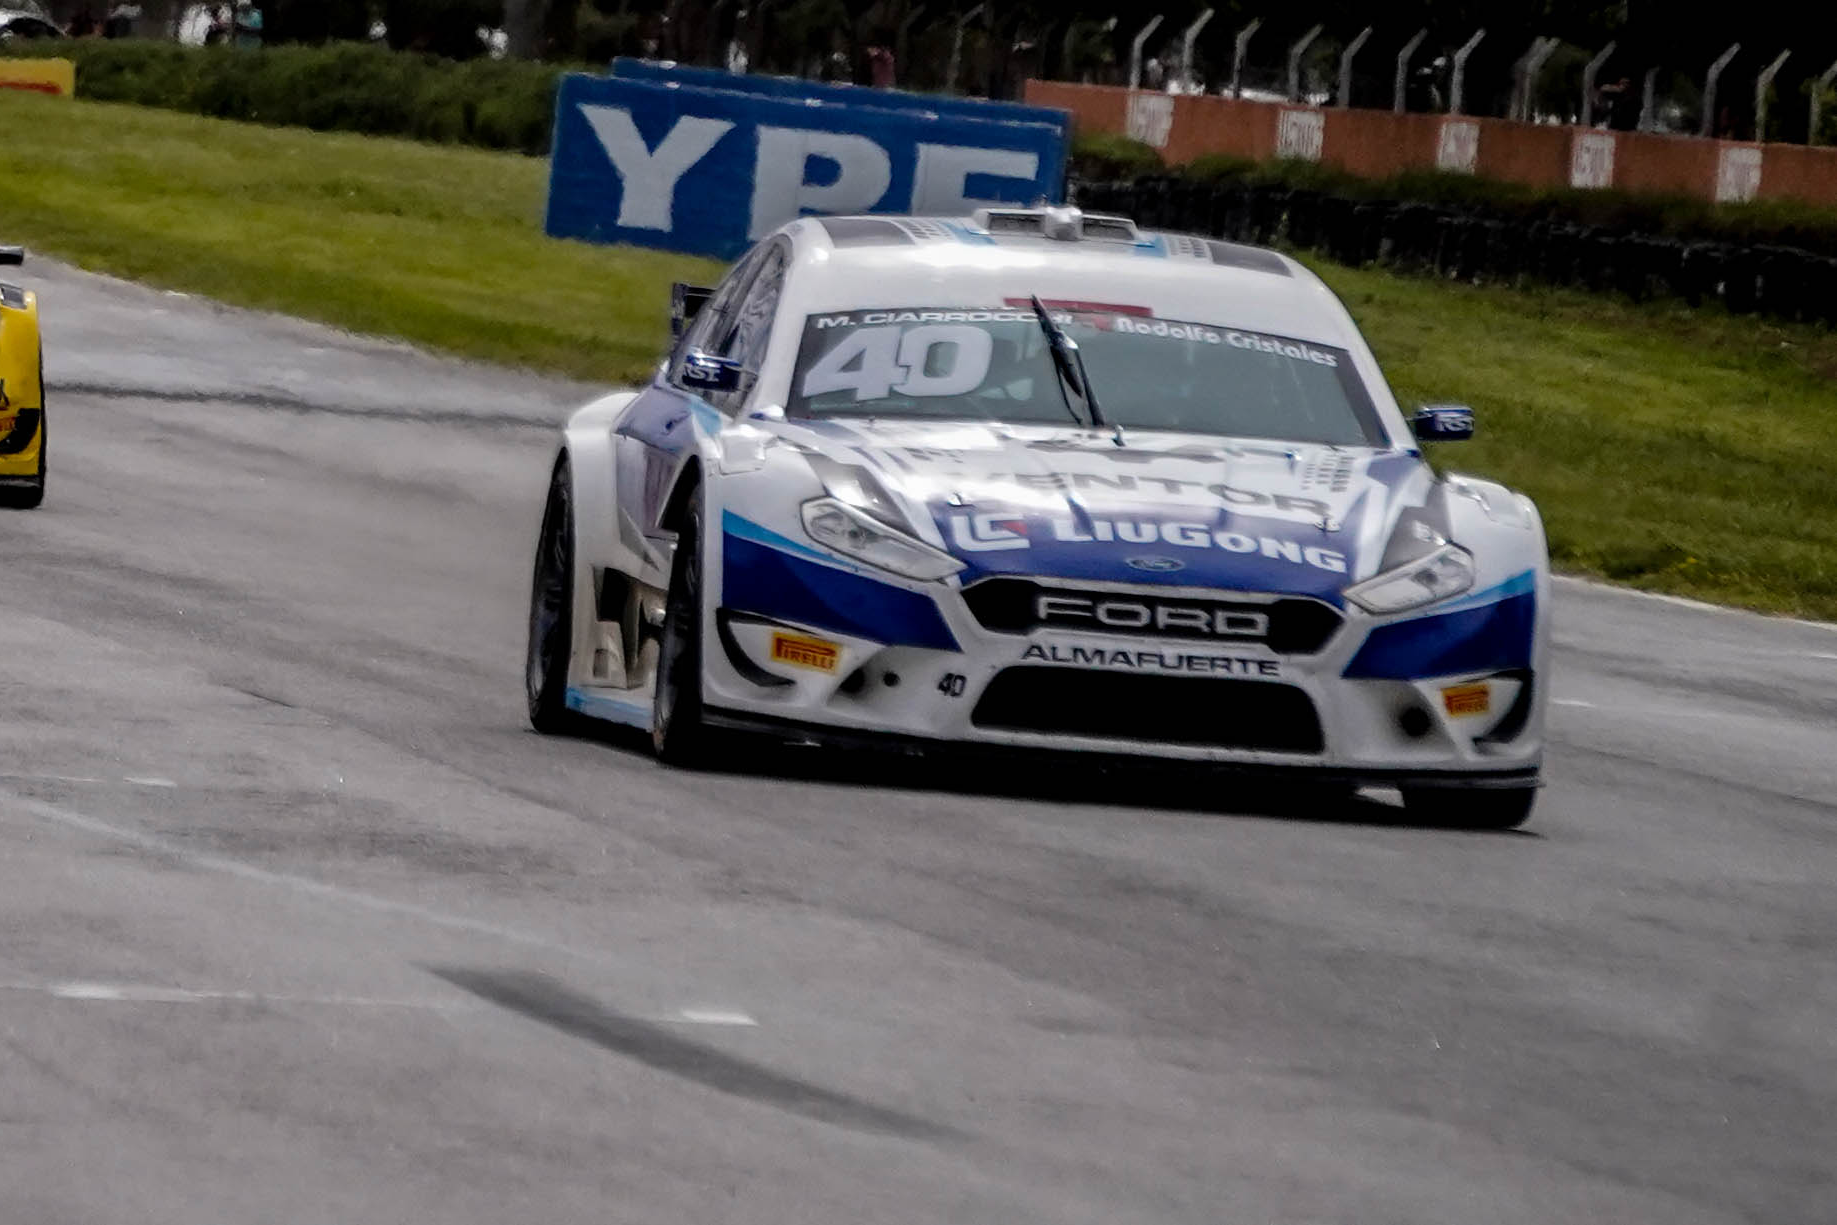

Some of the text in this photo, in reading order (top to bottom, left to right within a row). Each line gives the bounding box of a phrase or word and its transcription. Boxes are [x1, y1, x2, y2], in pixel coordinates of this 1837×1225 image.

[817, 316, 857, 329] M.
[1115, 317, 1338, 368] Rodolfo Cristales
[802, 325, 993, 402] 40
[1036, 594, 1268, 637] FORD
[775, 637, 837, 670] PIRELLI
[1021, 643, 1281, 677] ALMAFUERTE
[937, 672, 967, 698] 40
